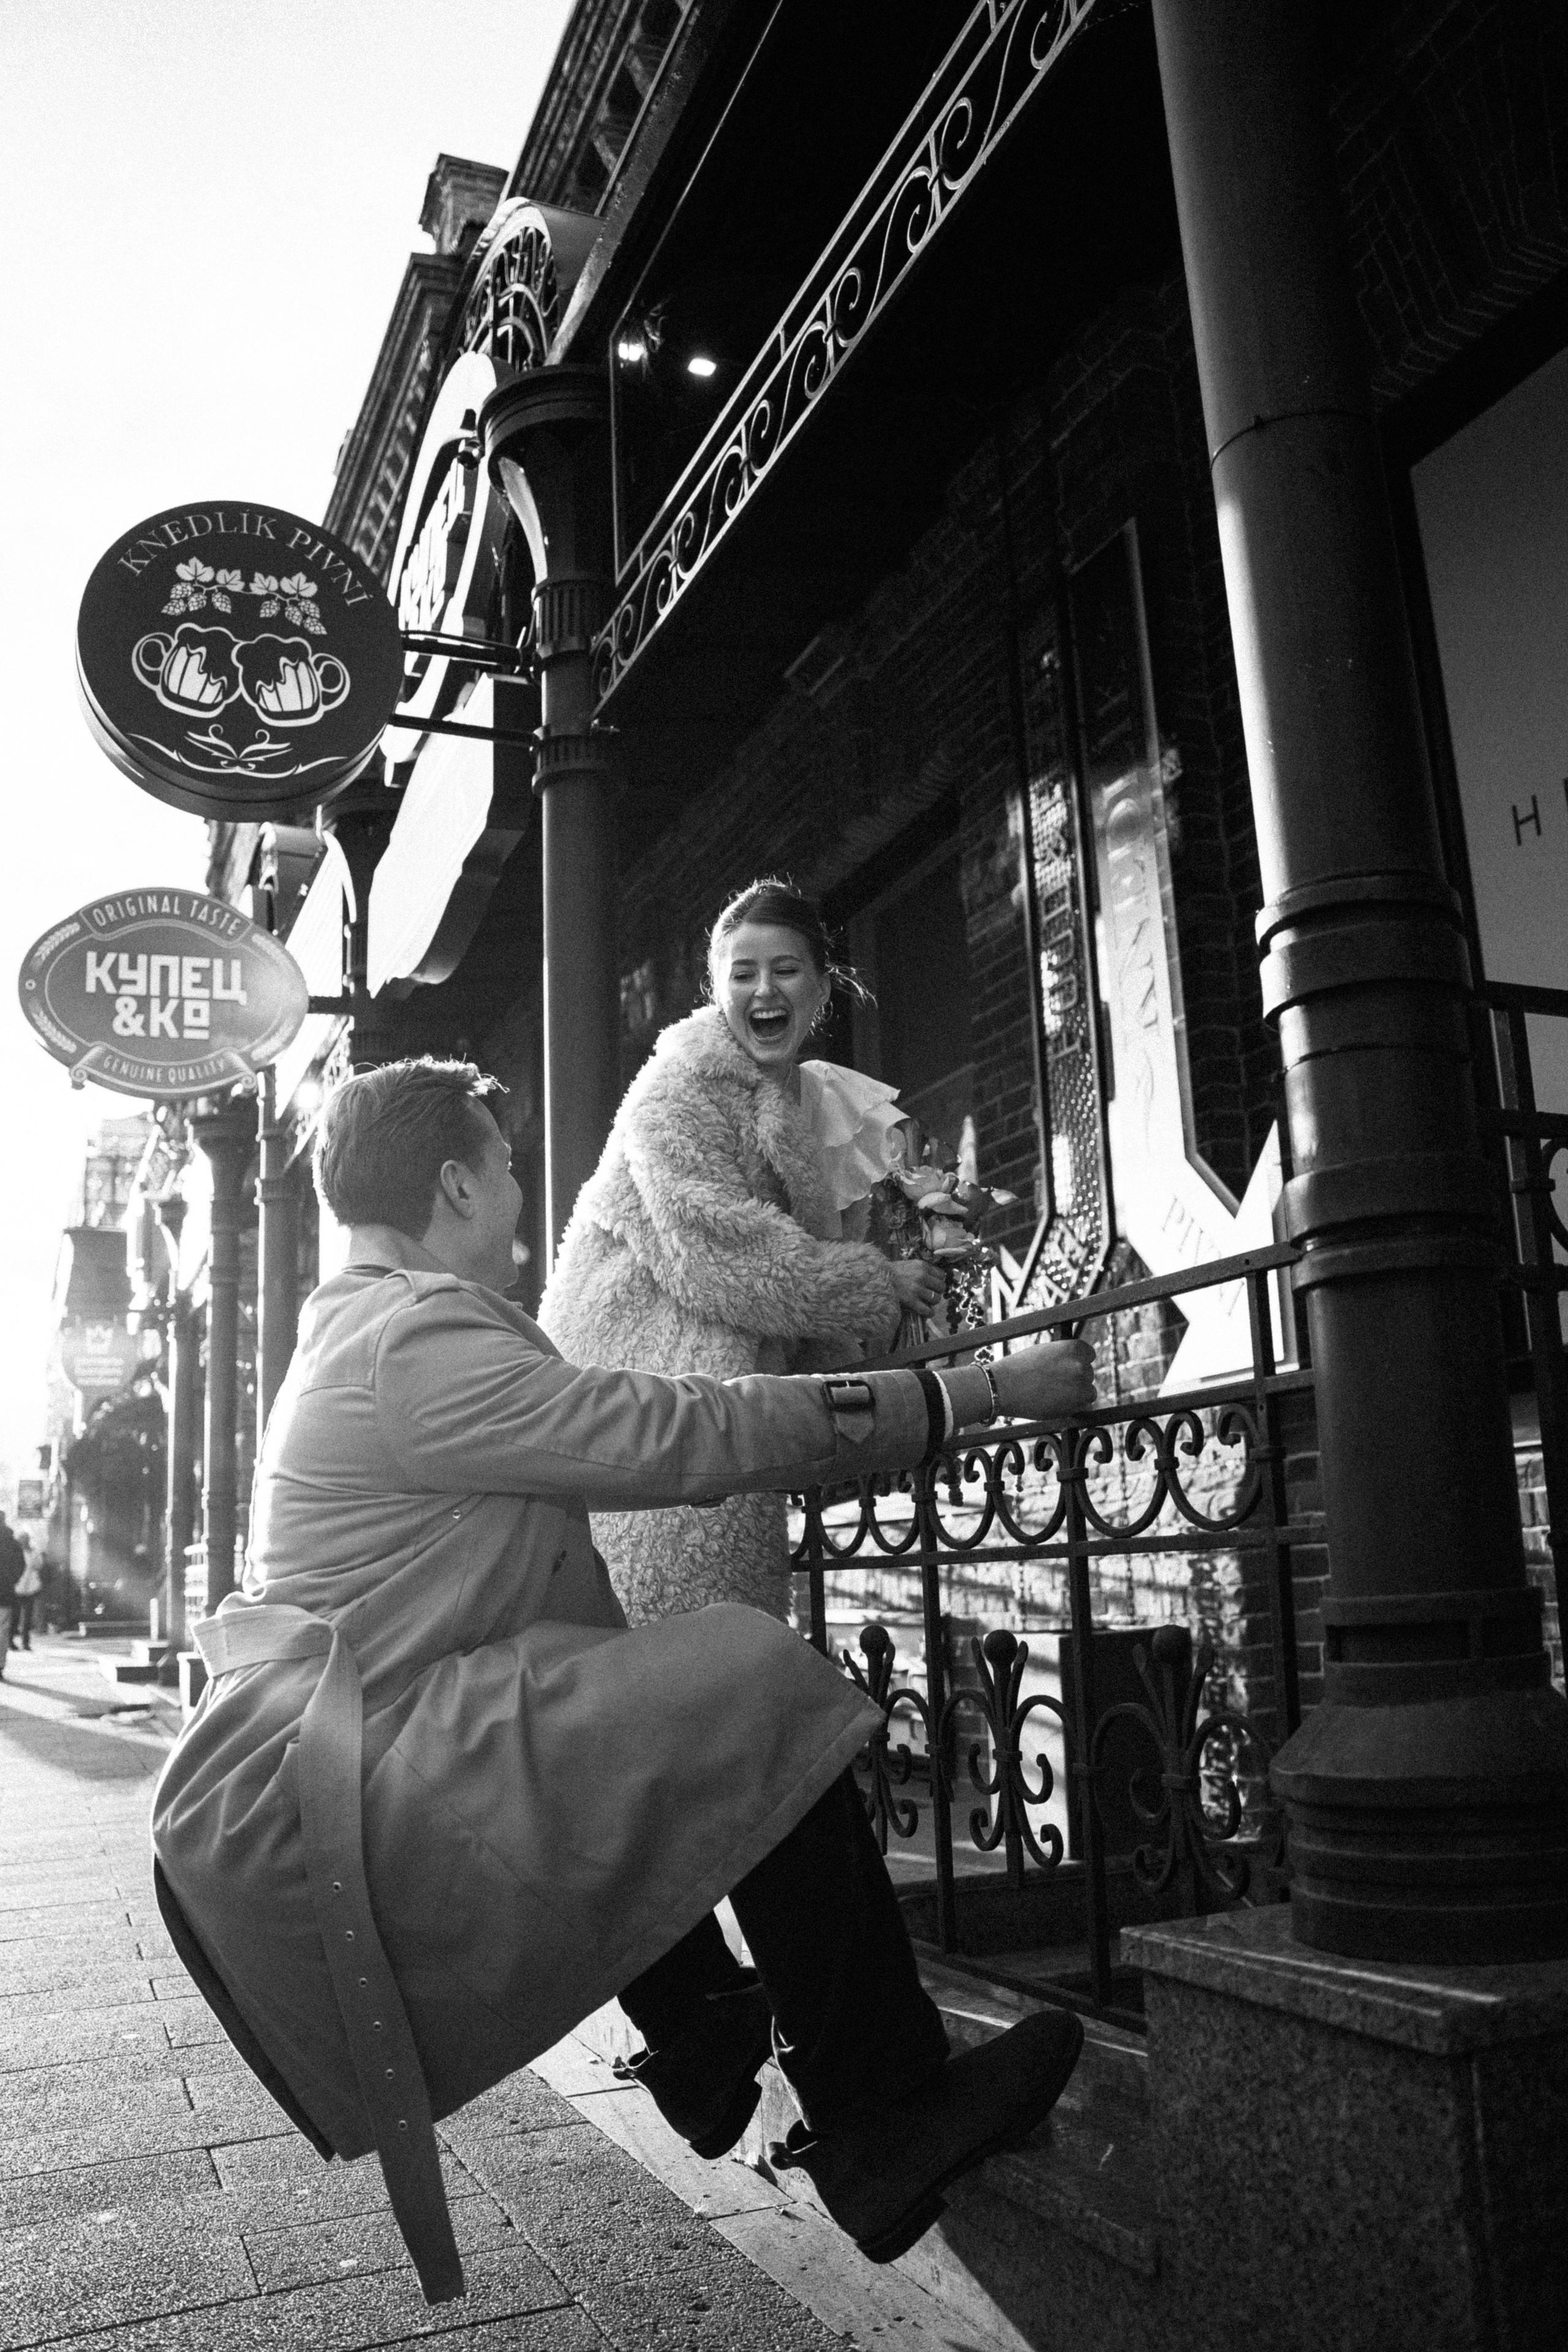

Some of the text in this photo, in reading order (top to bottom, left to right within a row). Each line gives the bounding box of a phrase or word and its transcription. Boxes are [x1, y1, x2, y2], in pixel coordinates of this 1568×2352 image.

[117, 508, 374, 607] KNEDLÍK PIVNÍ
[92, 894, 241, 937] ORIGINAL TASTE
[103, 1054, 225, 1085] GENUINE QUALITY
